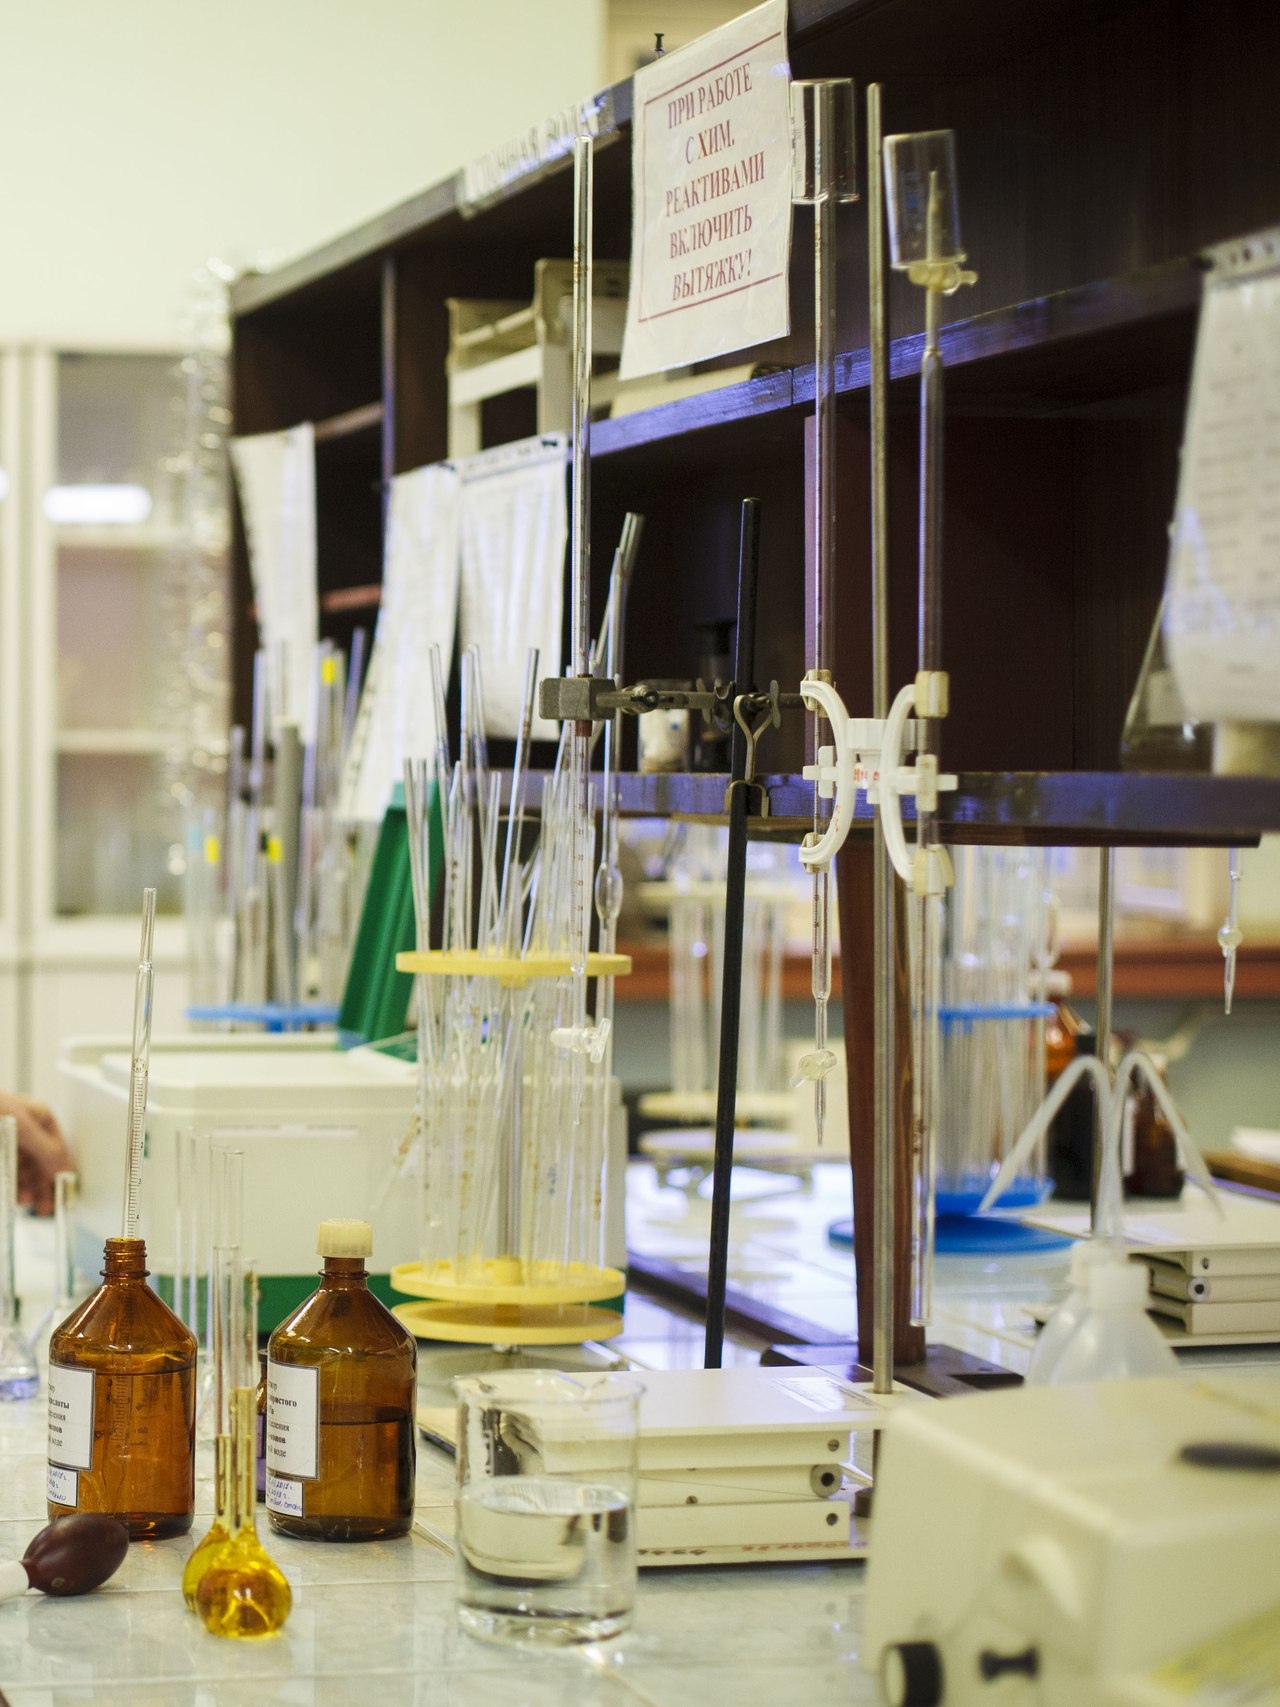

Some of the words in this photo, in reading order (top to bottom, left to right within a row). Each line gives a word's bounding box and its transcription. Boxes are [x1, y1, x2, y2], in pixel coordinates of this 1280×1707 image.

[668, 91, 695, 129] ПРИ
[697, 63, 752, 114] РАБОТЕ
[685, 136, 696, 165] С
[698, 119, 734, 160] ХИМ.
[666, 151, 765, 218] РЕАКТИВАМИ
[670, 204, 753, 260] ВКЛЮЧИТЬ
[672, 248, 752, 302] ВЫТЯЖКУ!
